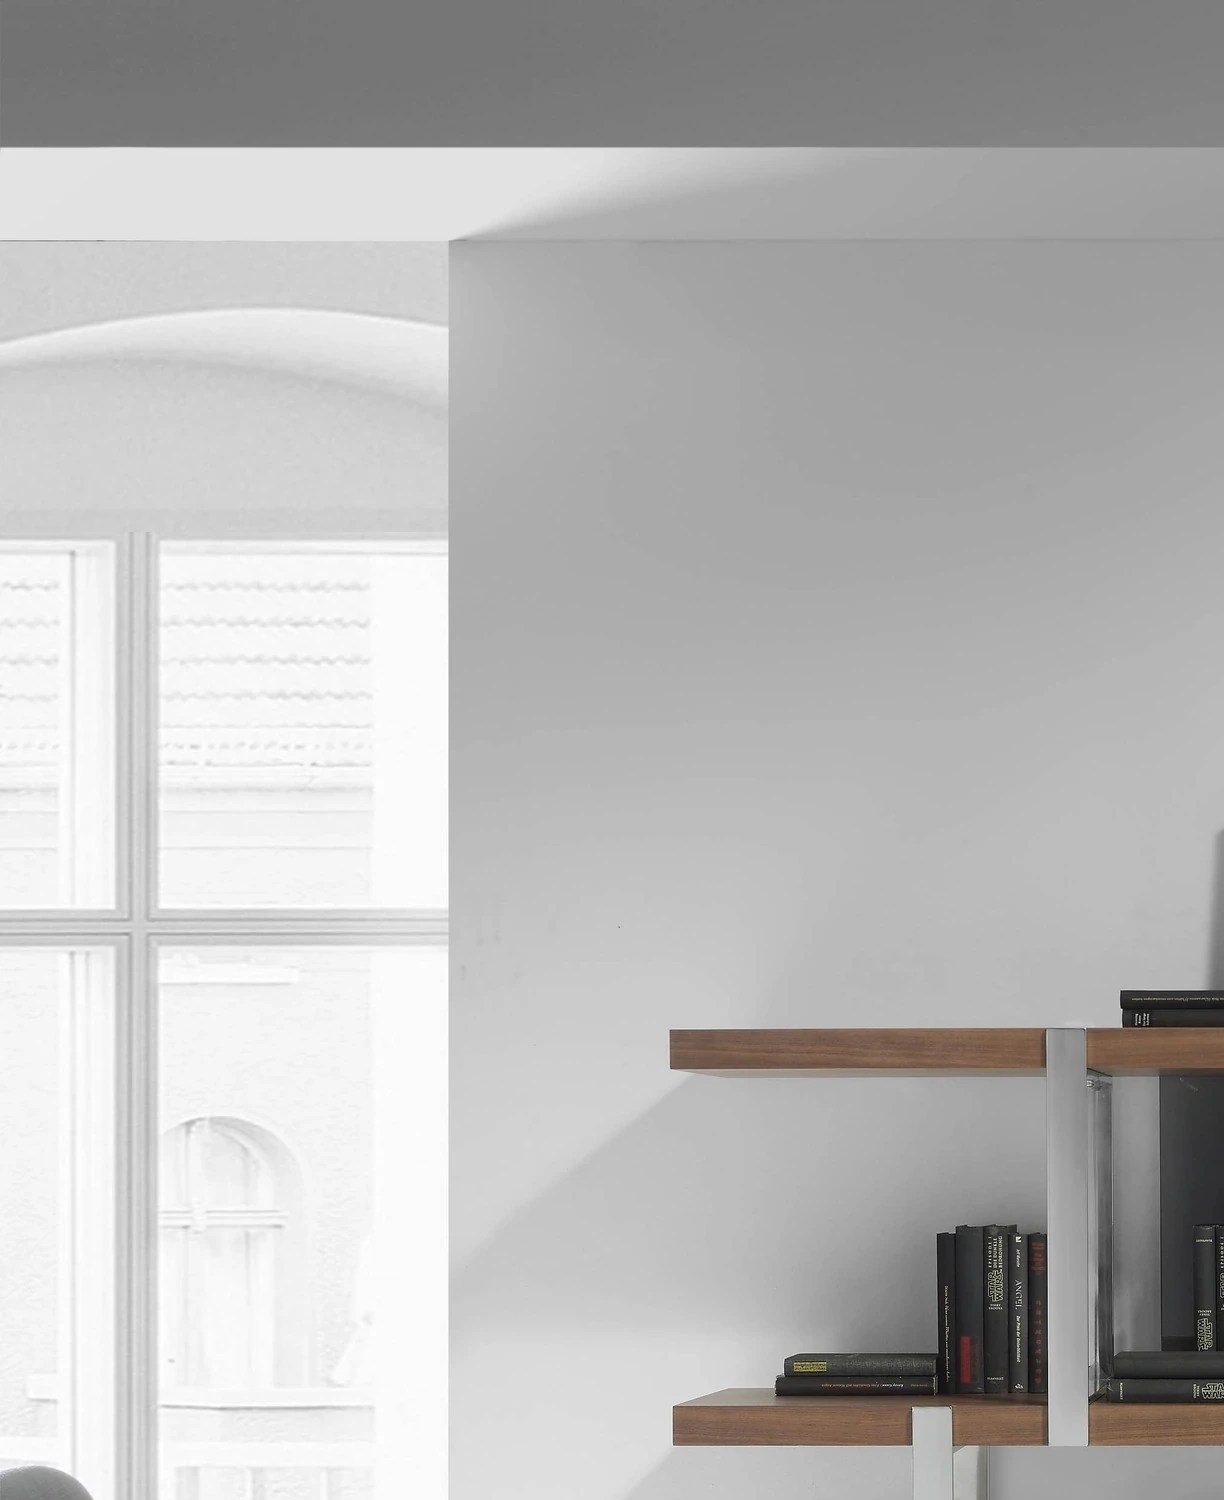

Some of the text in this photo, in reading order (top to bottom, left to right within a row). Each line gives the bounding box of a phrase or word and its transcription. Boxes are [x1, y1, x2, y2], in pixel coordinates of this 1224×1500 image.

[987, 1270, 996, 1302] STAR
[994, 1269, 1004, 1302] WARS
[1015, 1279, 1023, 1310] ANGEL
[1204, 1318, 1213, 1349] STAR
